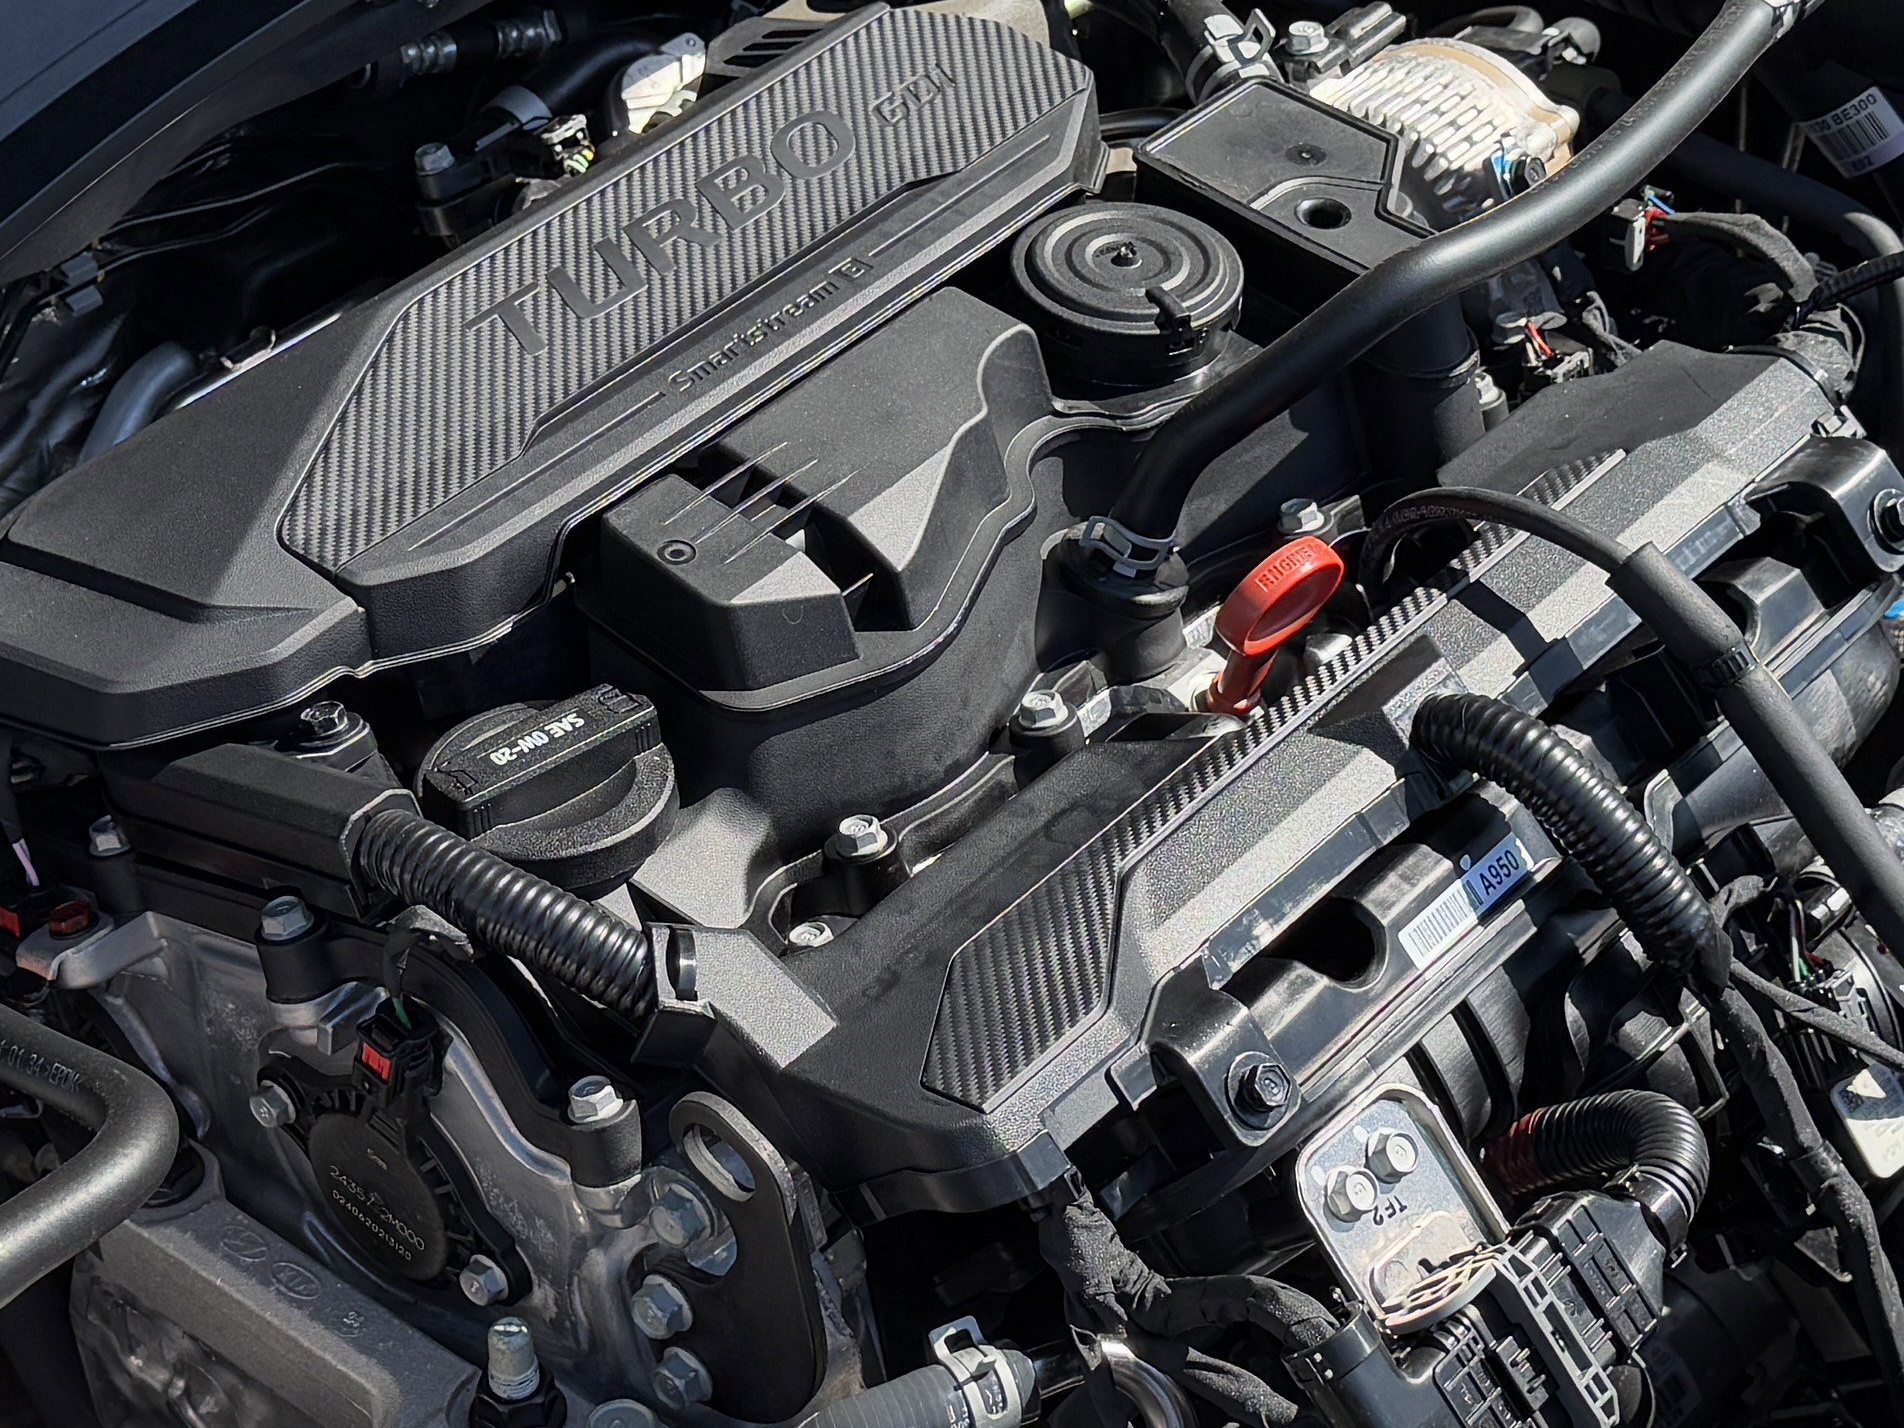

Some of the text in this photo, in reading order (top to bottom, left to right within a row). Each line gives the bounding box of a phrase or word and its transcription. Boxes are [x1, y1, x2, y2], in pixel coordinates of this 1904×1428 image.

[468, 111, 856, 356] TURBO
[669, 275, 837, 394] Smartstream
[490, 713, 586, 766] SAE 0W-20
[1481, 849, 1520, 897] A950
